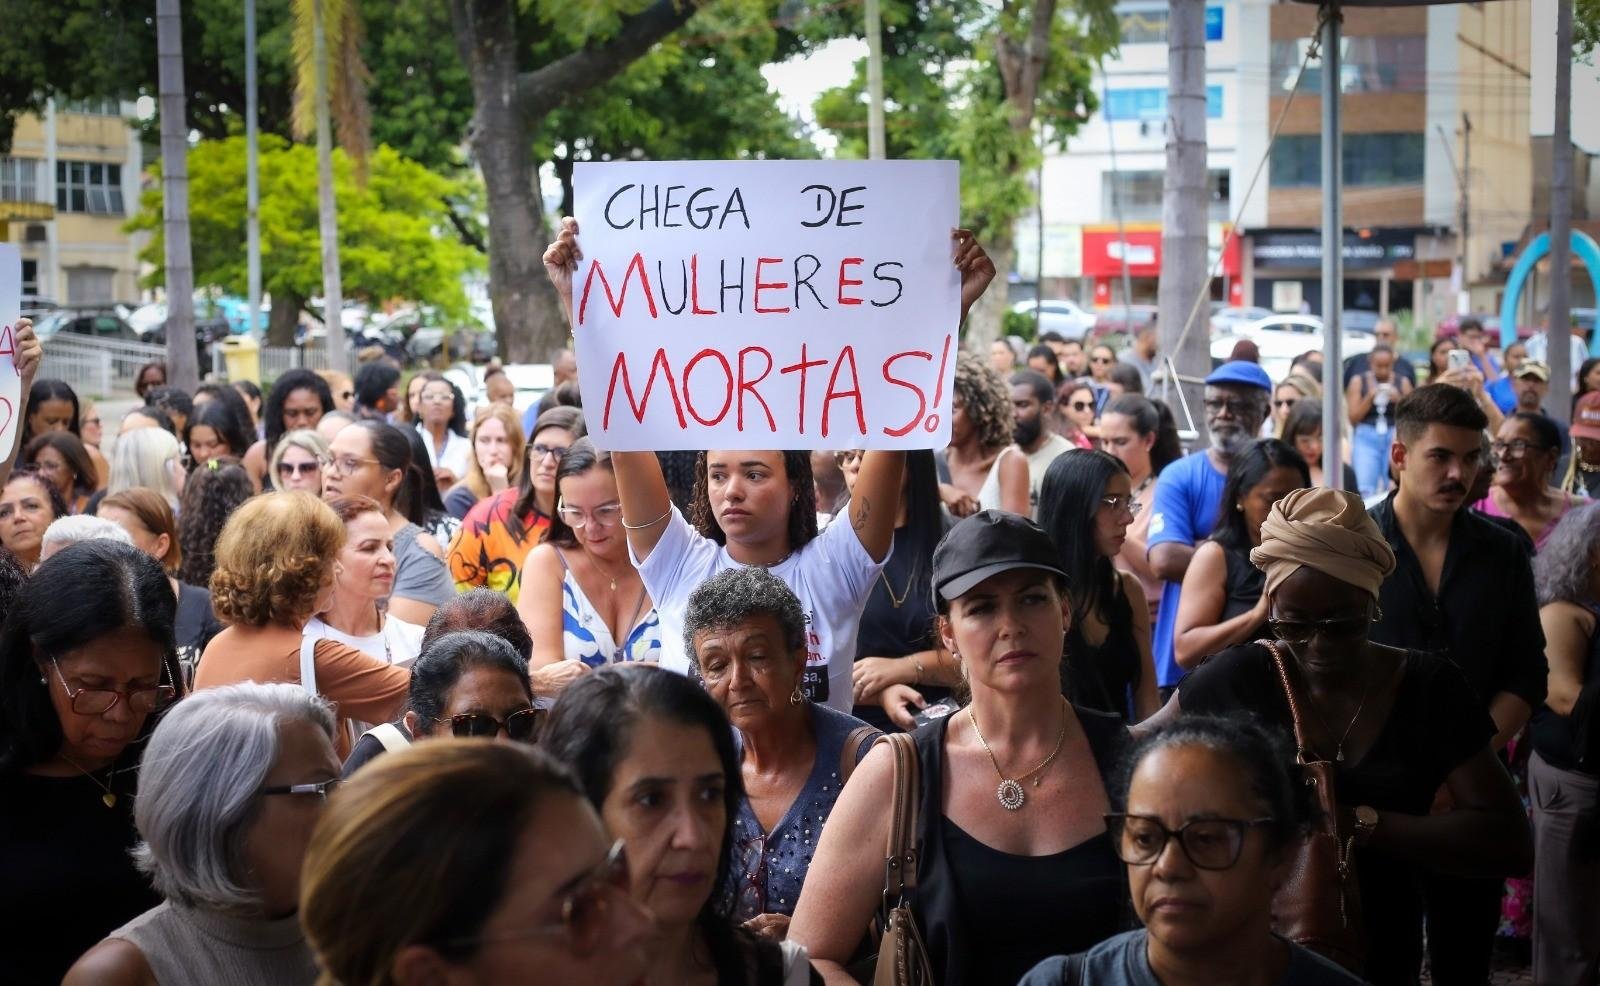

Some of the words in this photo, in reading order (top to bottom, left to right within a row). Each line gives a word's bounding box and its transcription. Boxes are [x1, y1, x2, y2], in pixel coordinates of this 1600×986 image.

[604, 184, 750, 230] CHEGA
[800, 184, 867, 227] DE
[579, 252, 904, 325] MULHERES
[603, 333, 952, 438] MORTAS!
